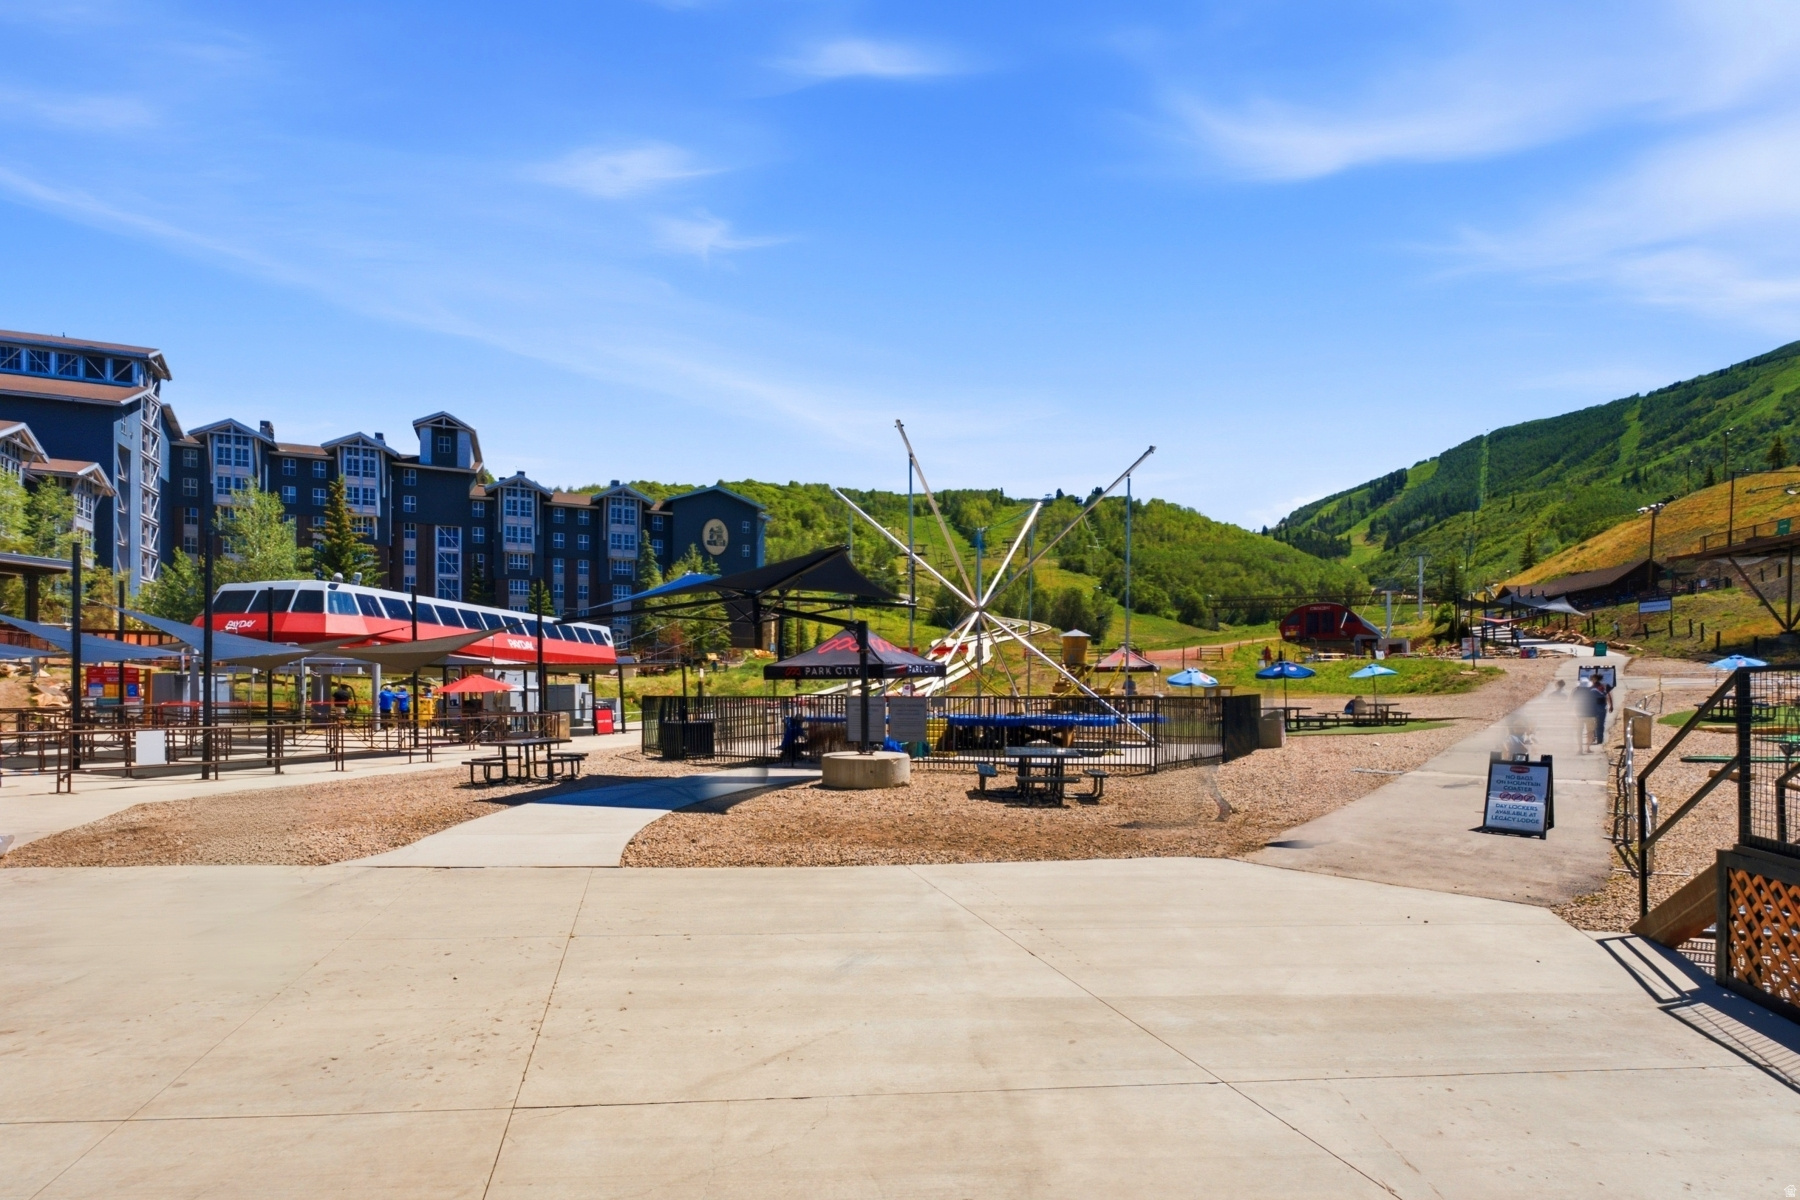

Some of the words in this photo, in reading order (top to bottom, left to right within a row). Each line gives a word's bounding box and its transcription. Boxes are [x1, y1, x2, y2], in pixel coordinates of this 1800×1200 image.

[225, 620, 256, 630] PAYDAY
[805, 666, 832, 675] PARK
[835, 666, 860, 675] CITY
